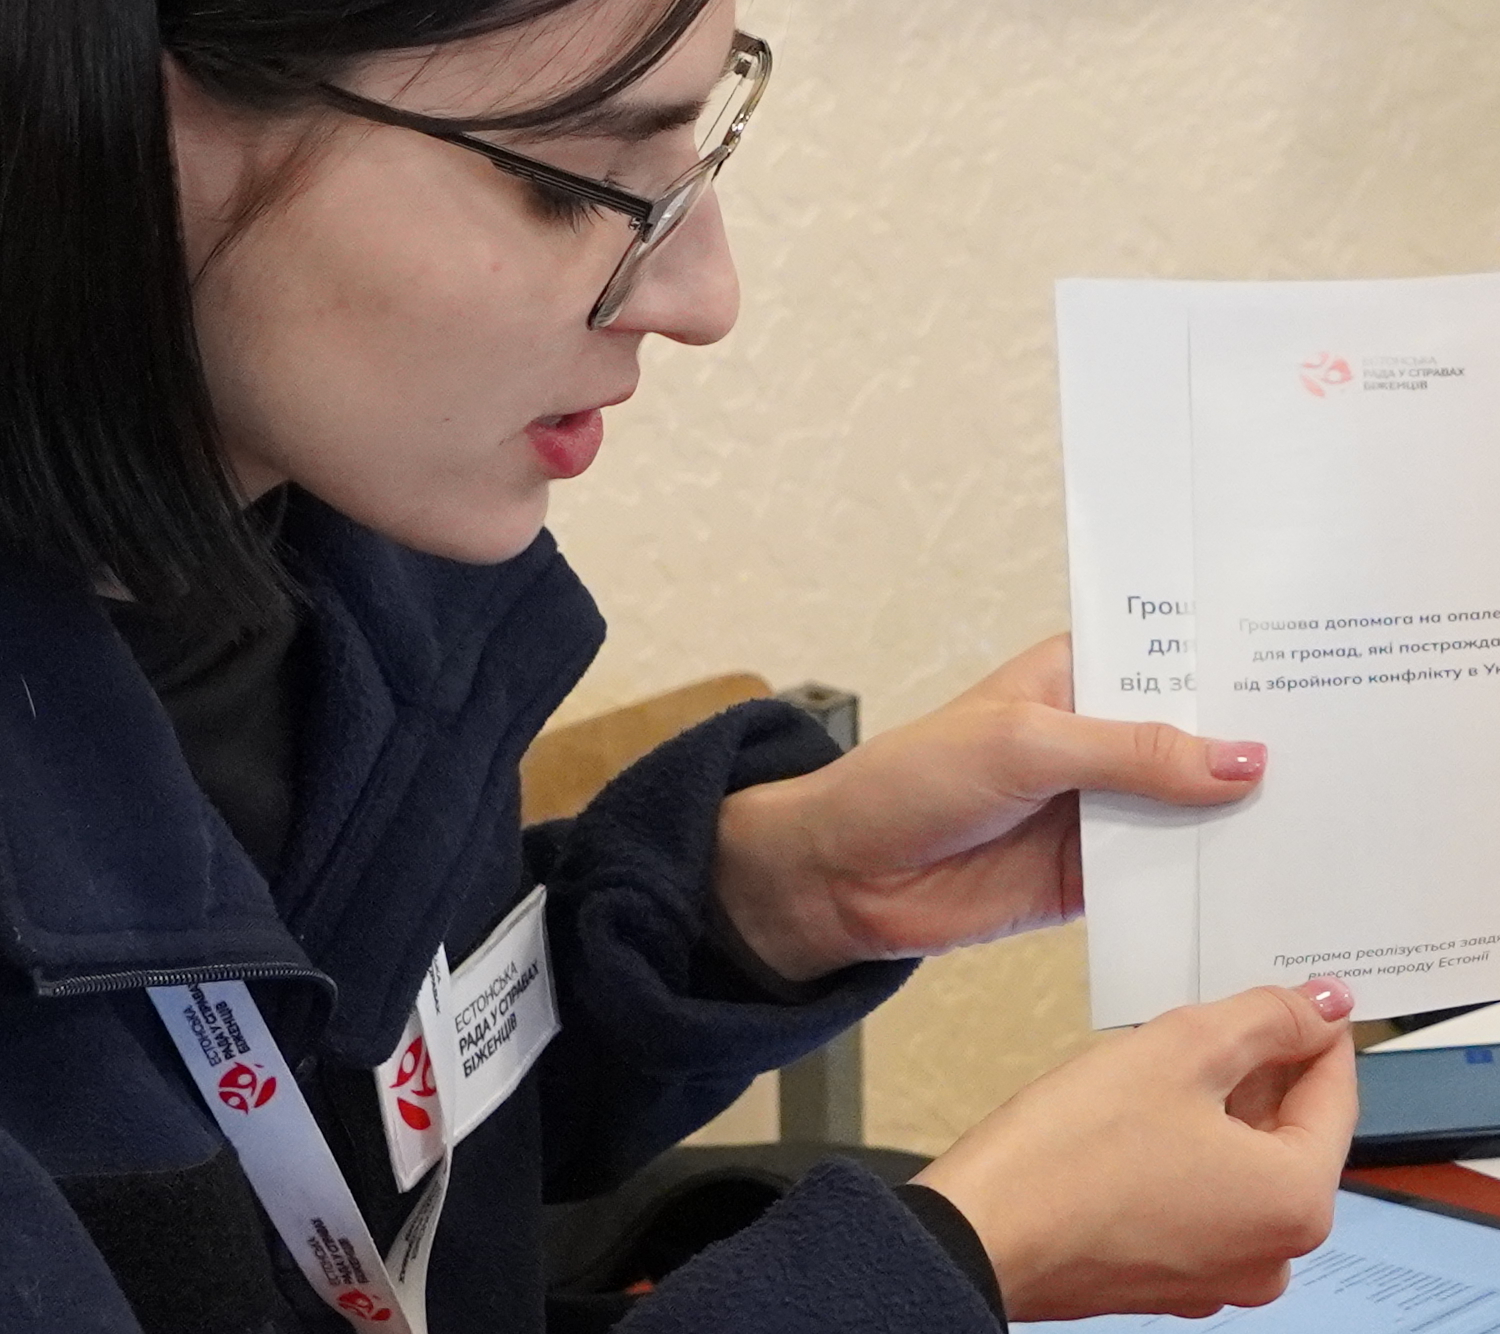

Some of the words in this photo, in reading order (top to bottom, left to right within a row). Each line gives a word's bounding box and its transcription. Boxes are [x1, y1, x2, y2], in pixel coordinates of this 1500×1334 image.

[1239, 617, 1319, 634] Грошова
[1325, 614, 1414, 631] допомога
[1419, 612, 1441, 625] на
[1252, 647, 1286, 663] для
[1291, 644, 1363, 661] громад,
[1368, 641, 1393, 655] які
[1120, 671, 1161, 694] від
[1233, 677, 1260, 692] від
[1266, 672, 1362, 692] збройного
[1368, 666, 1462, 685] конфлікту
[1468, 667, 1479, 677] в
[1273, 950, 1351, 967] Програма
[1355, 940, 1456, 960] реалізується
[1377, 961, 1434, 976] народу
[1438, 951, 1490, 967] Естонії
[454, 961, 518, 1033] ЕСТОНСЬКА
[459, 1017, 491, 1055] РАДА
[490, 1005, 497, 1026] У
[499, 959, 539, 1016] СПРАВАХ
[183, 1005, 221, 1067] ЕСТОНСЬКА
[216, 1001, 250, 1054] БІЖЕНЦІВ
[214, 1031, 236, 1060] РАДА
[462, 1012, 517, 1078] БІЖЕНЦІВ
